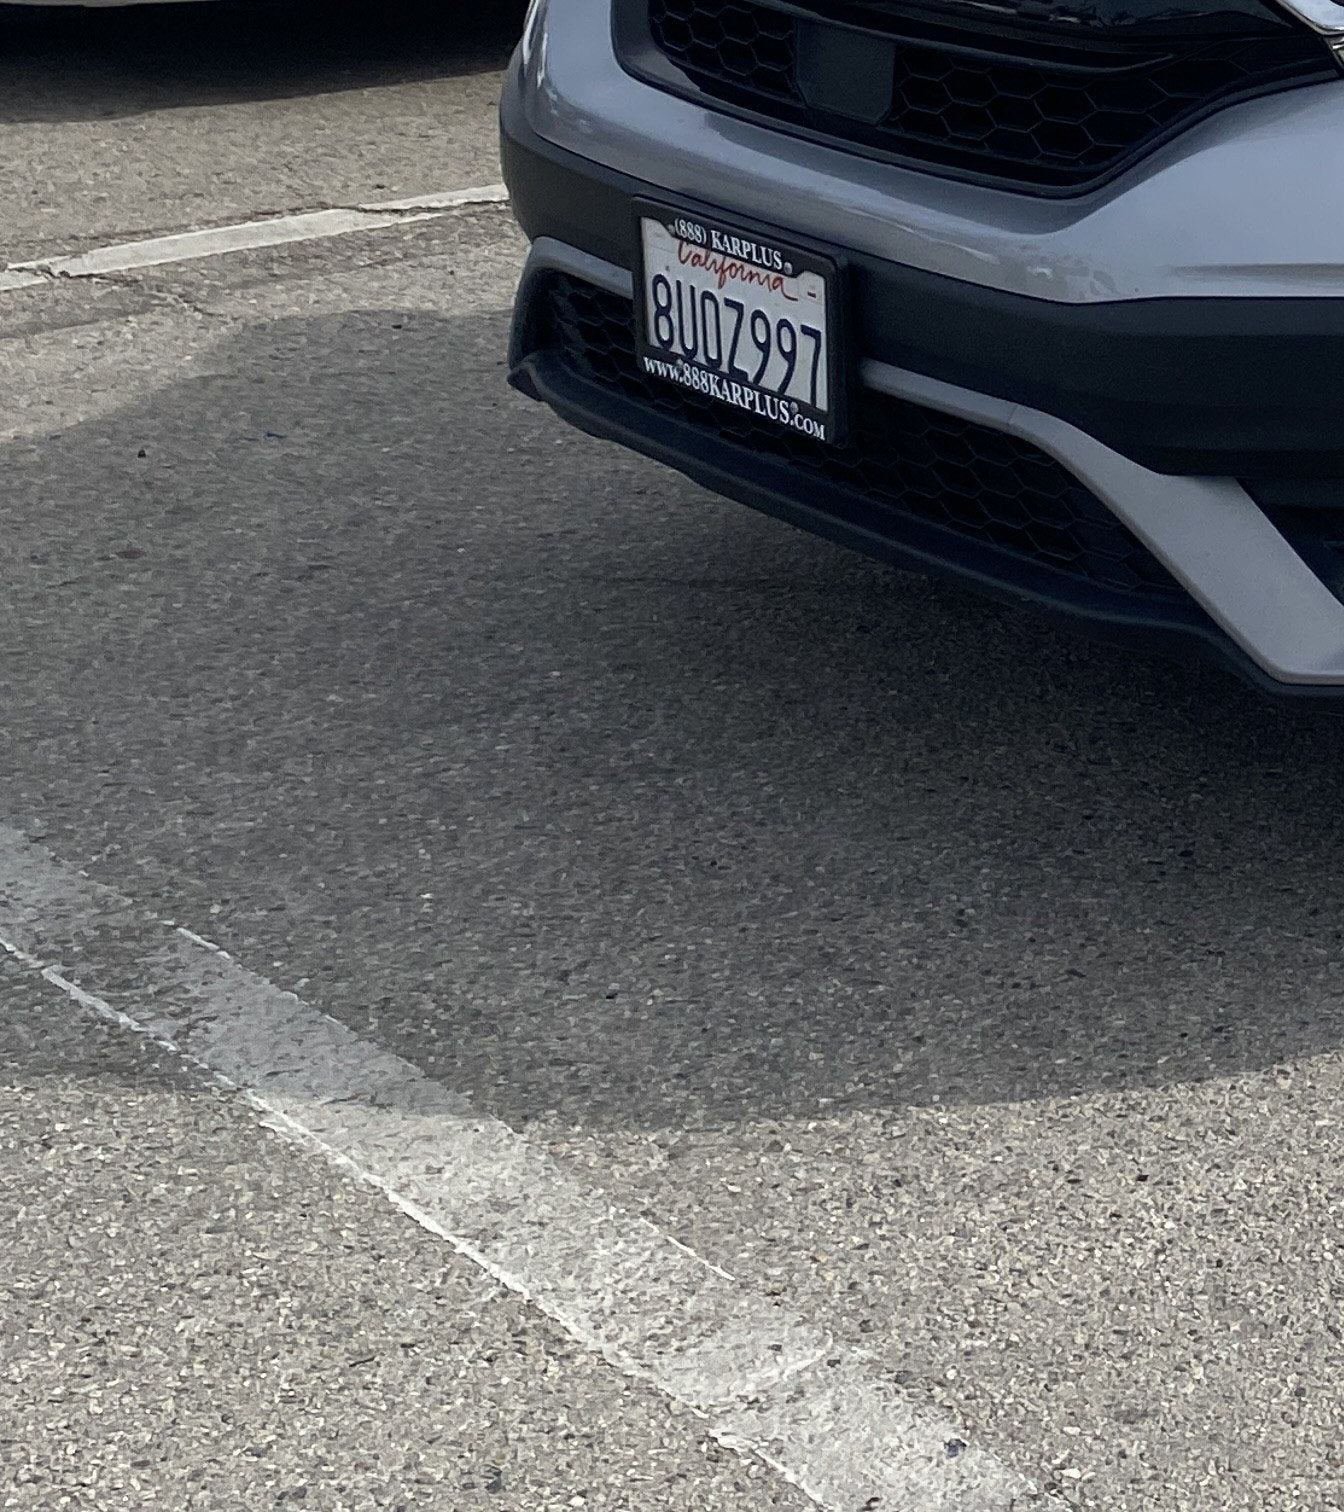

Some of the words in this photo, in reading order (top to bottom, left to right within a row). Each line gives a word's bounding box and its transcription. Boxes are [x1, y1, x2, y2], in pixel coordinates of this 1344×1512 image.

[674, 217, 707, 245] (888)
[710, 229, 783, 271] KARPLUS
[677, 240, 799, 302] California
